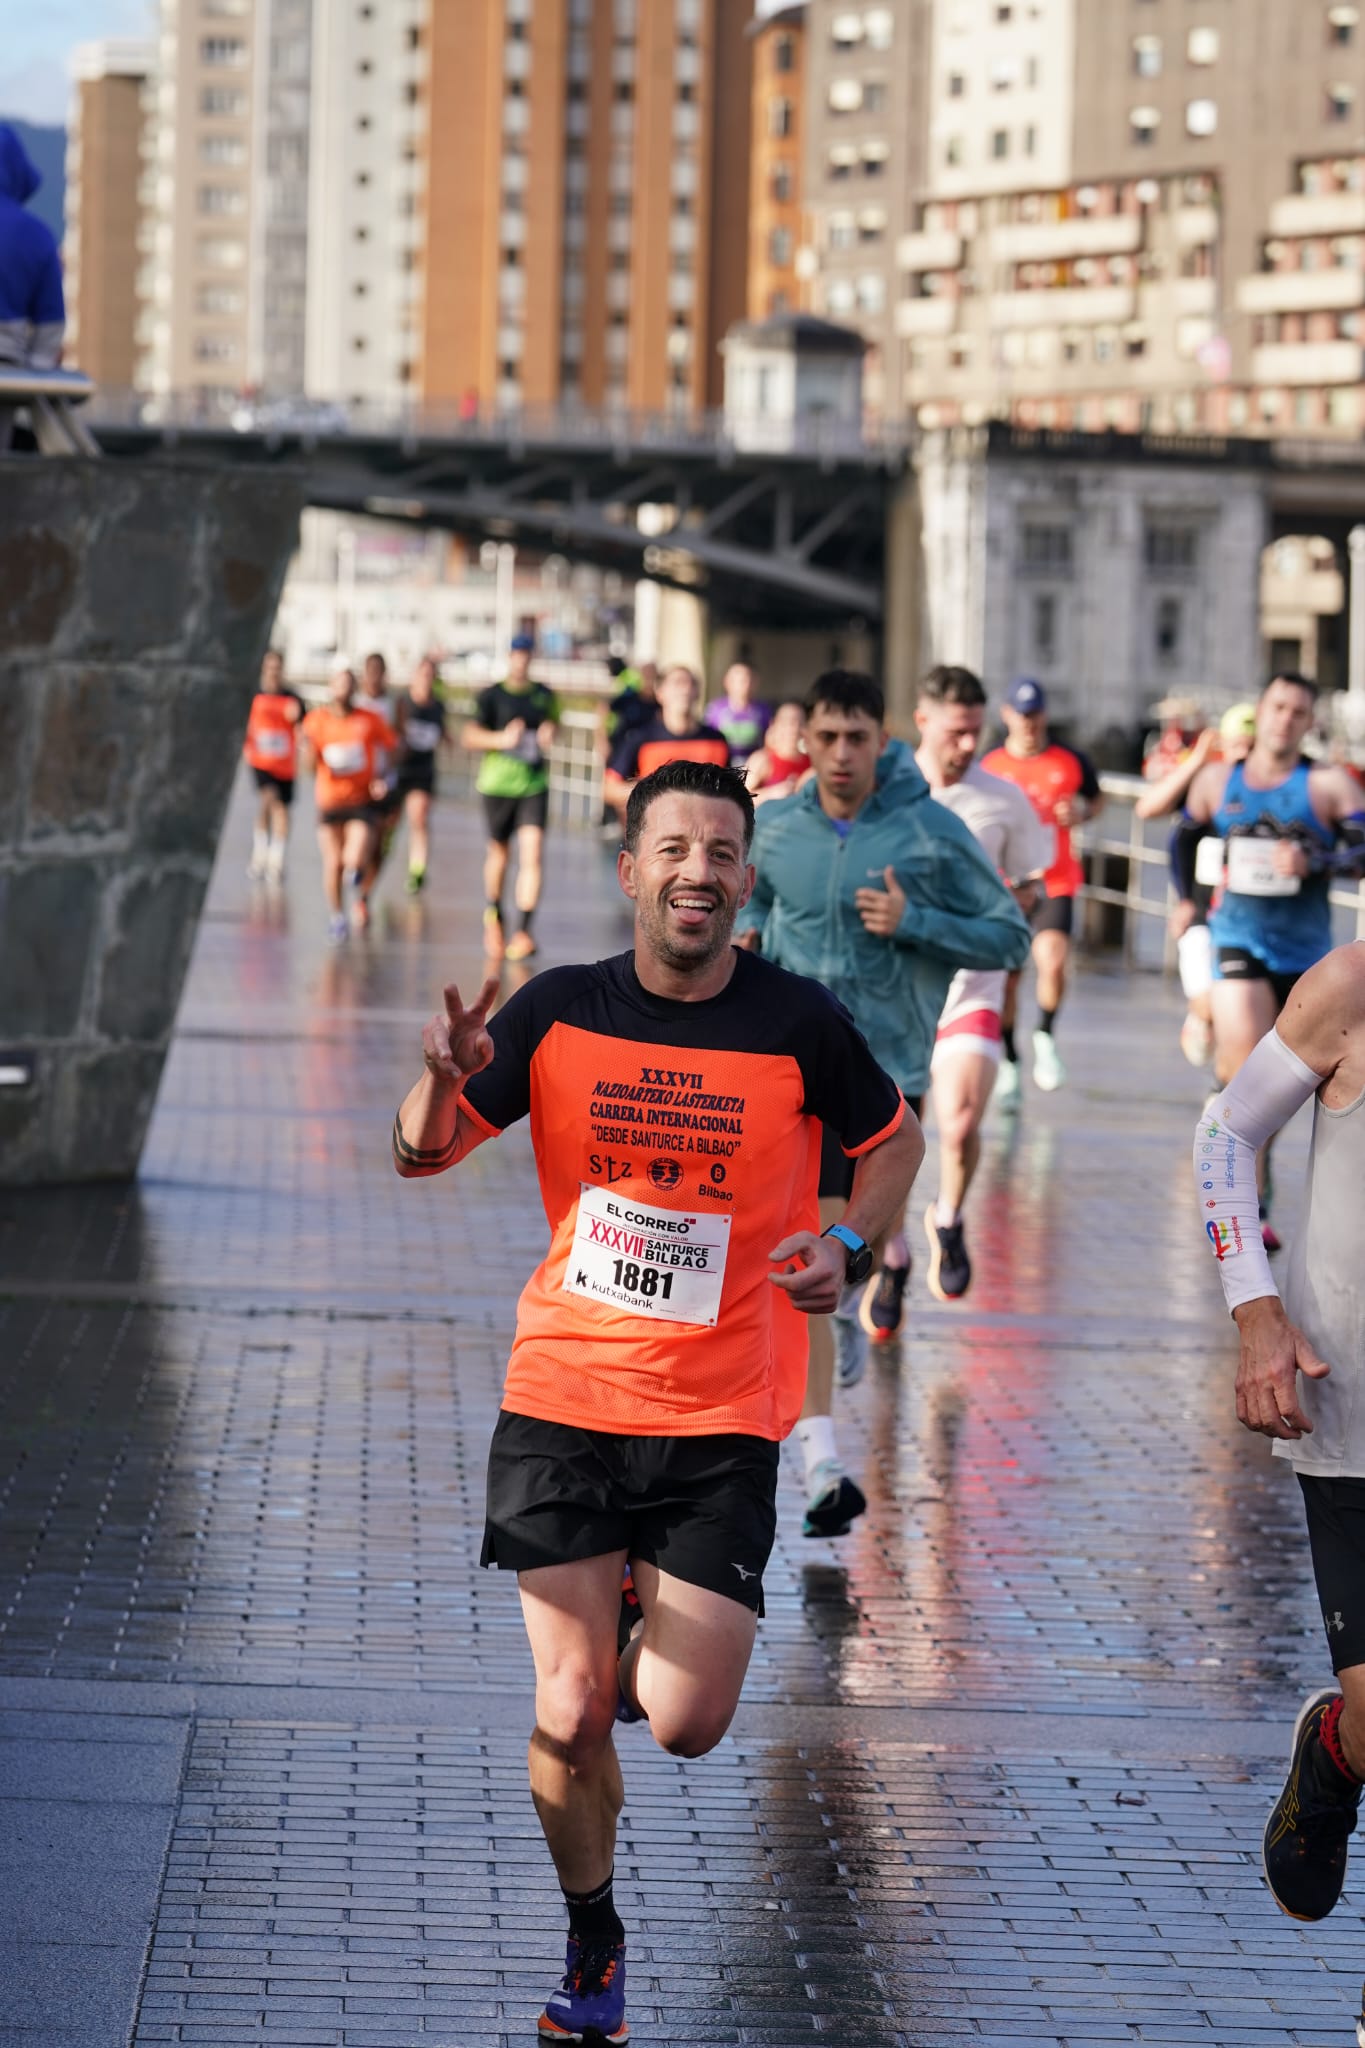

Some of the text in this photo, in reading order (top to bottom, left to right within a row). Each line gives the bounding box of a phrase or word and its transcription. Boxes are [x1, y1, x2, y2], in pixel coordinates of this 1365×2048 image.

[639, 1068, 703, 1089] XXXVII
[592, 1081, 745, 1113] NAZIOARTEKO LASTERKETA
[590, 1102, 743, 1134] CARRERA INTERNACIONAL
[630, 1130, 685, 1151] SANTURCE
[686, 1137, 694, 1153] A
[698, 1184, 733, 1201] Bilbao
[606, 1202, 690, 1234] EL CORREO
[588, 1218, 645, 1259] XXXVII
[646, 1239, 709, 1257] SANTURCE
[645, 1249, 707, 1269] BILBAO
[612, 1259, 674, 1300] 1881
[591, 1280, 654, 1310] kutxabank
